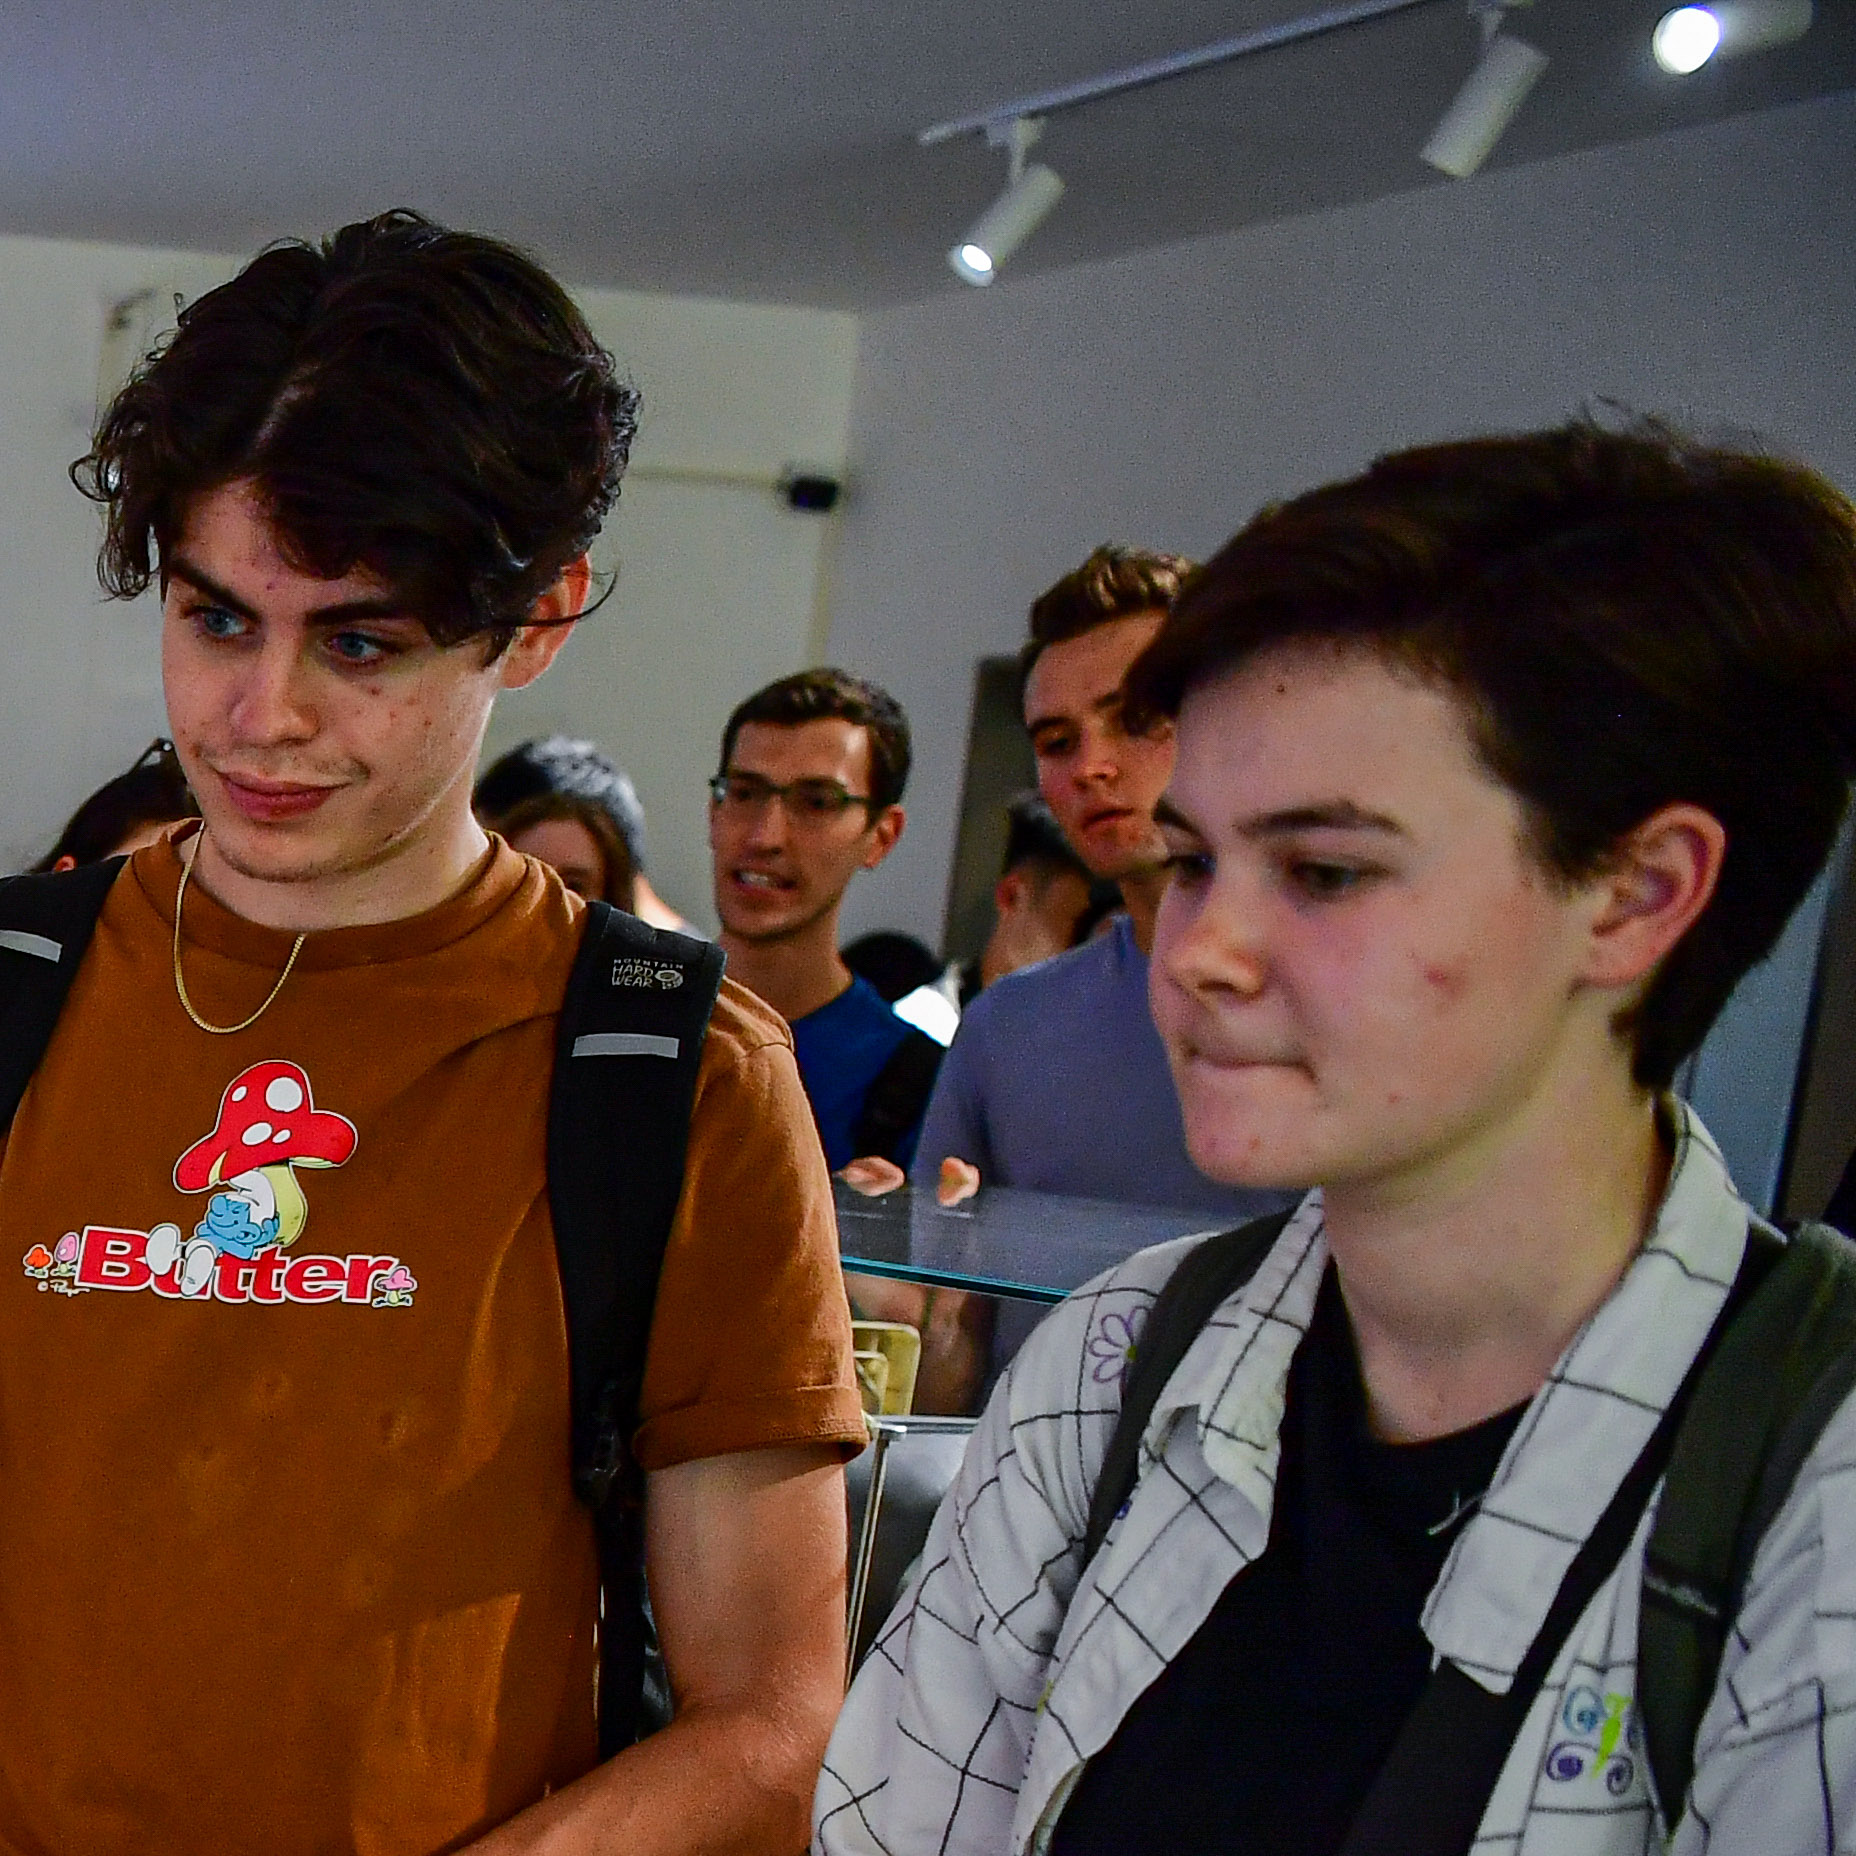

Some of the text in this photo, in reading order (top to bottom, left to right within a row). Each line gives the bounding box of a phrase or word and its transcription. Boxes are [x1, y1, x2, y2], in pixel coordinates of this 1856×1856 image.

[612, 964, 654, 978] HARD
[613, 958, 684, 970] MOUNTAIN
[611, 974, 654, 988] WEAR
[75, 1225, 404, 1305] Butter
